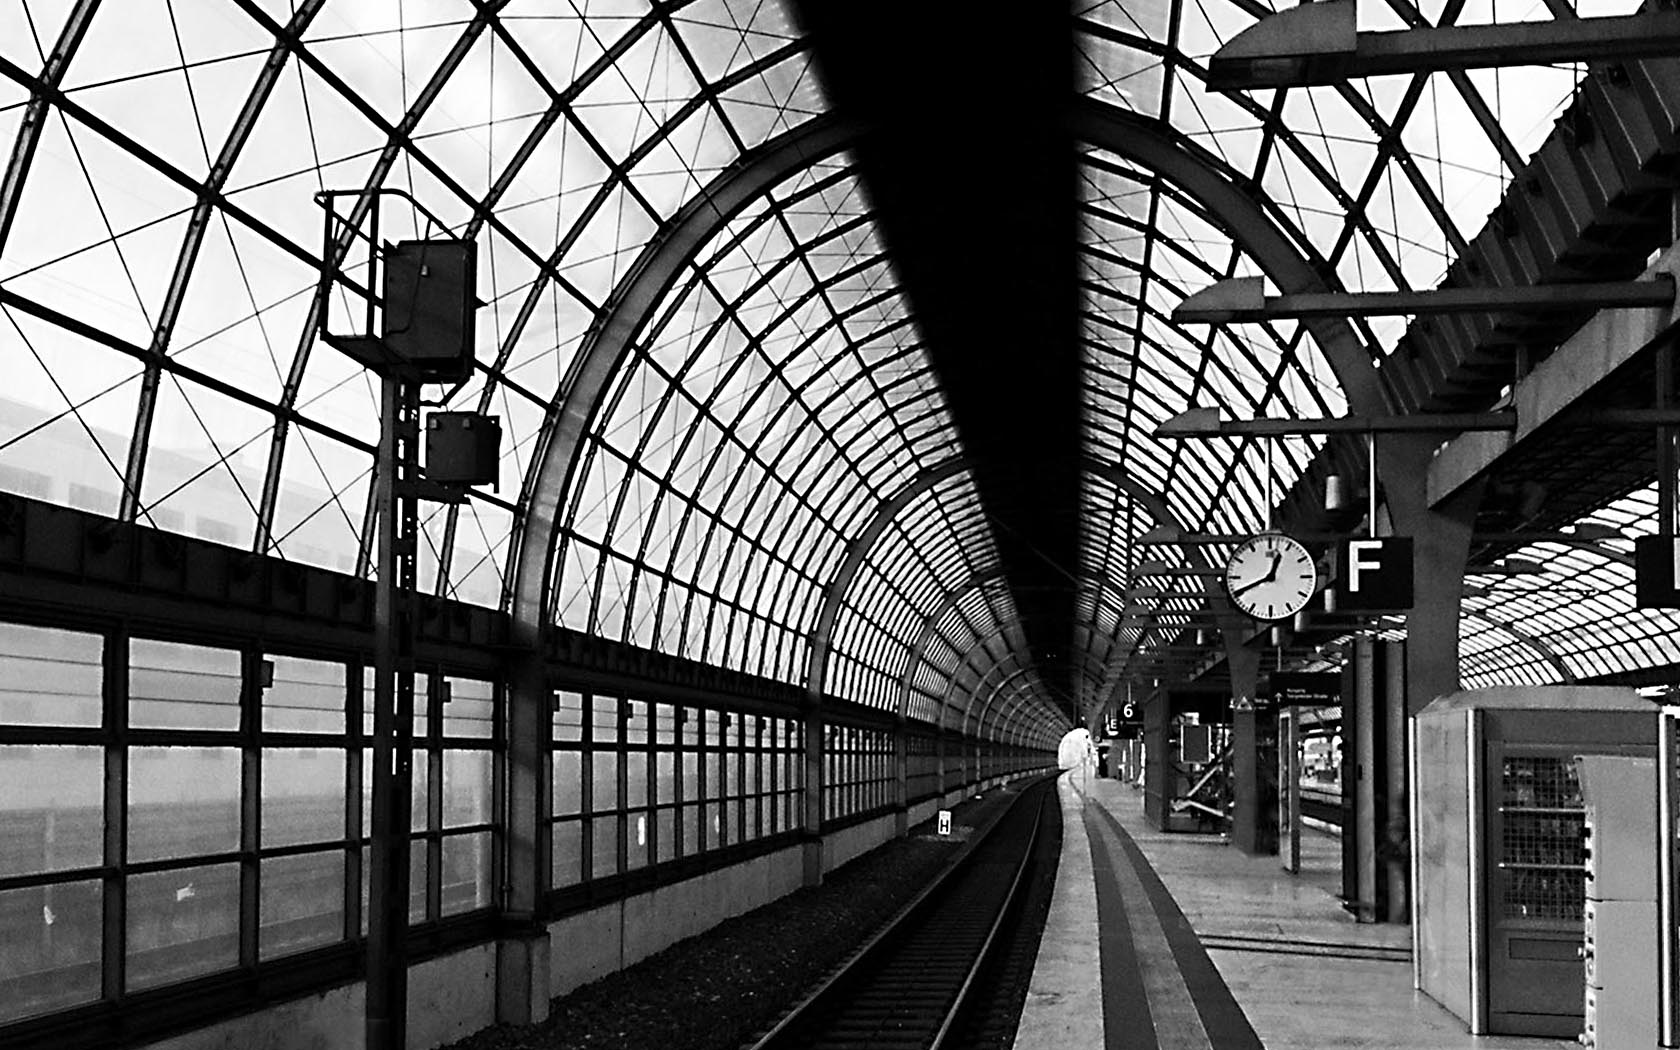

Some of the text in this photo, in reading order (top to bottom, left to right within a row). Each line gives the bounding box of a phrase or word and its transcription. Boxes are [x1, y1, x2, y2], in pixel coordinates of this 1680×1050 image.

[1349, 540, 1383, 592] F
[1123, 703, 1134, 718] 6
[1110, 718, 1117, 729] E
[940, 818, 949, 833] H
